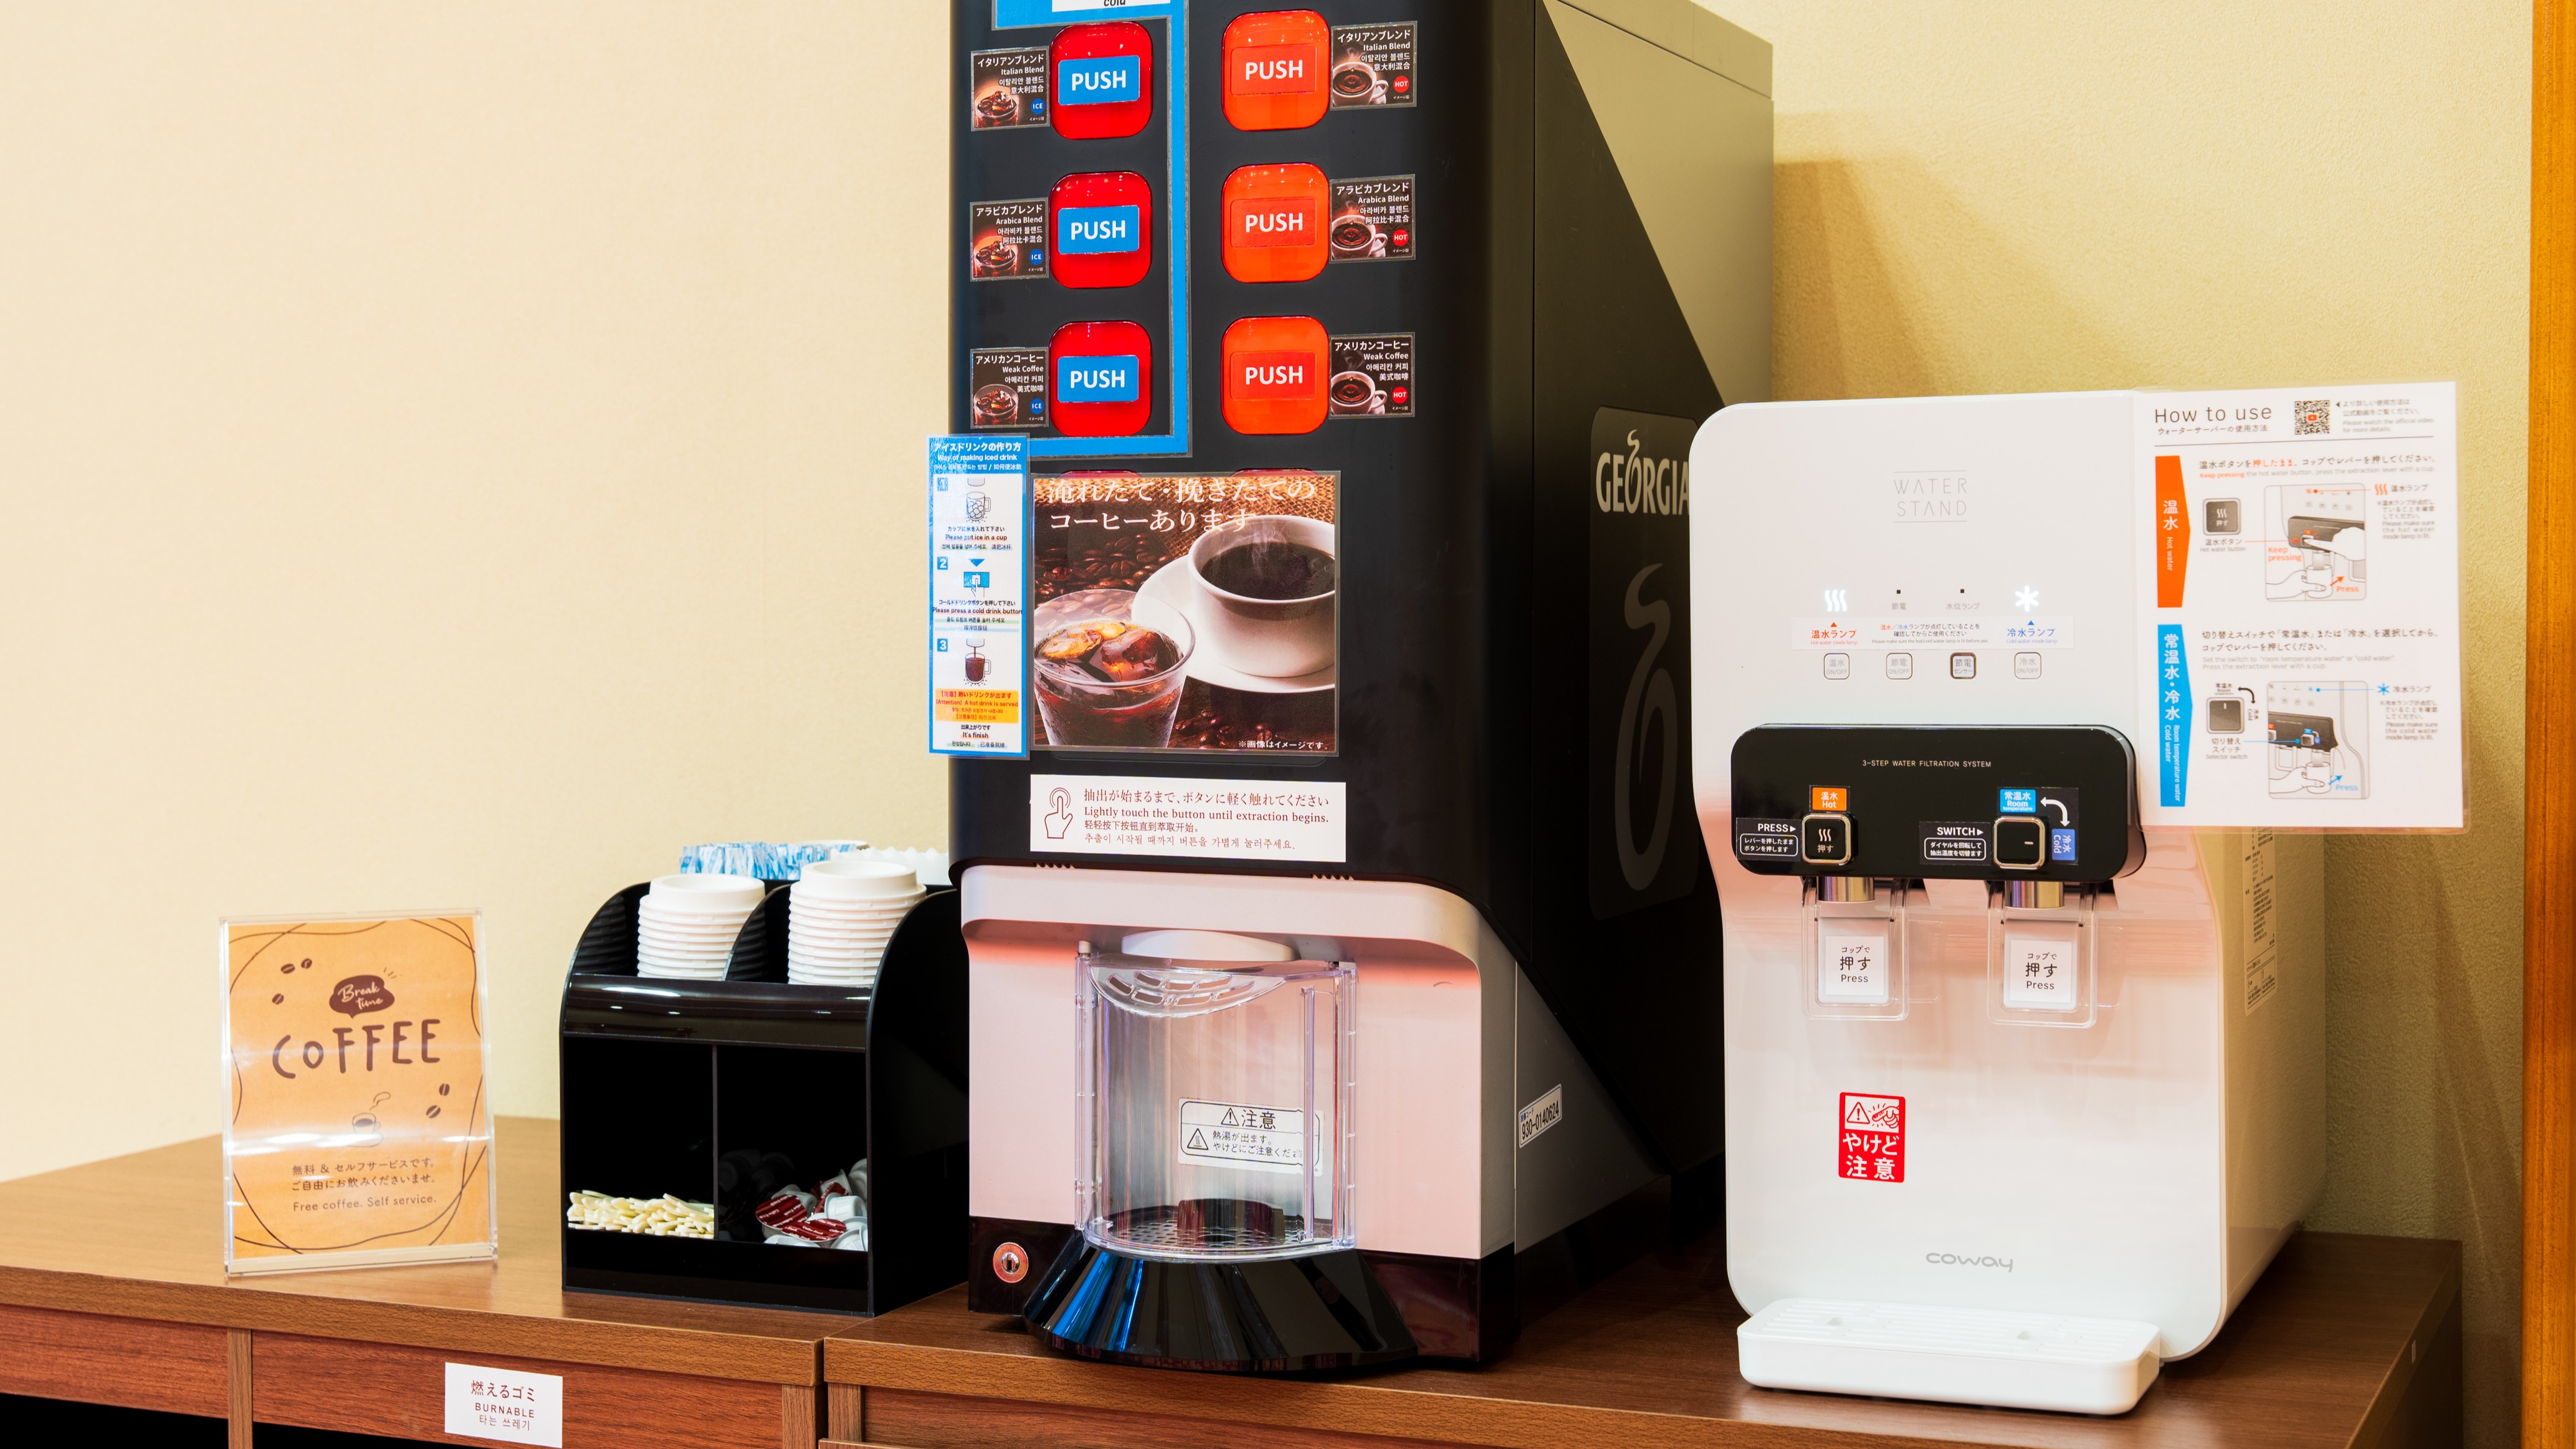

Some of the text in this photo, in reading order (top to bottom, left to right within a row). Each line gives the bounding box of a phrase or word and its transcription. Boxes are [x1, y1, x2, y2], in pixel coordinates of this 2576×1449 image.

[1338, 29, 1411, 42] イタリアンブレンド
[978, 54, 1044, 67] イタリアンブレンド
[1362, 53, 1410, 62] 이탈리안 블렌드
[1024, 65, 1044, 74] Blend
[1245, 60, 1304, 80] PUSH
[1374, 62, 1410, 71] 意大利混合
[1071, 70, 1127, 91] PUSH
[1011, 85, 1044, 94] 意大利混合
[1337, 183, 1409, 195] アラビカブレンド
[976, 204, 1042, 216] アラビカブレンド
[1245, 213, 1304, 232] PUSH
[998, 227, 1022, 235] 아라비카
[1070, 220, 1126, 241] PUSH
[1335, 341, 1409, 351] アメリカンコーヒー
[976, 354, 1043, 365] アメリカンコーヒー
[1071, 370, 1125, 388] PUSH
[1246, 366, 1302, 385] PUSH
[2155, 407, 2271, 423] How to use
[935, 442, 1021, 452] アイスドリンクの作り方
[1596, 429, 1689, 515] GEORGIA
[1047, 479, 1315, 504] 淹れたて・挽きたての
[1893, 478, 1967, 494] WATER
[1897, 500, 1967, 517] STAND
[2163, 500, 2178, 530] 温水
[1051, 509, 1256, 533] コーヒーあります
[940, 558, 947, 568] 2
[1811, 629, 1857, 639] 温水ランプ
[2007, 628, 2055, 637] 冷水ランプ
[940, 641, 947, 649] 3
[1955, 659, 1972, 667] 節電
[2164, 633, 2180, 720] 常温水・冷水
[1239, 740, 1327, 749] ※画像はイメージです。
[1084, 788, 1329, 807] 抽出が始まるまで、ボタンに軽く触れてください
[1821, 791, 1838, 800] 温水
[2005, 791, 2031, 800] 常温水
[1084, 807, 1329, 824] Lightly touch the button until extraction begins.
[1084, 820, 1198, 833] 轻轻按下按钮直到萃取开始。
[1758, 823, 1788, 832] PRESS
[1937, 827, 1975, 836] SWITCH
[1085, 833, 1295, 849] 추출이 시작될 때까지 버튼을 가볍게 눌러주세요.
[1818, 844, 1834, 853] 押す
[2063, 834, 2071, 853] 冷水
[1841, 945, 1870, 954] コップで
[2027, 952, 2056, 960] コップで
[1840, 956, 1871, 971] 押す
[2026, 962, 2057, 977] 押す
[1841, 975, 1868, 983] Press
[2026, 980, 2054, 990] Press
[338, 982, 379, 1003] Break
[356, 998, 383, 1010] time
[1241, 1109, 1276, 1130] 注意
[1522, 1100, 1559, 1140] 930-0140624
[1213, 1131, 1271, 1145] 熱湯が出ます。
[1842, 1132, 1899, 1155] やけど
[292, 1157, 434, 1175] 無料 & セルフサービスです。
[1846, 1155, 1895, 1180] 注意
[292, 1174, 434, 1191] ご自由にお飲みくださいませ。
[293, 1194, 436, 1212] Free coffee. Self service.
[471, 1380, 535, 1402] 燃えるゴミ
[475, 1402, 534, 1418] BURNABLE
[479, 1415, 530, 1431] 타는 쓰레기
